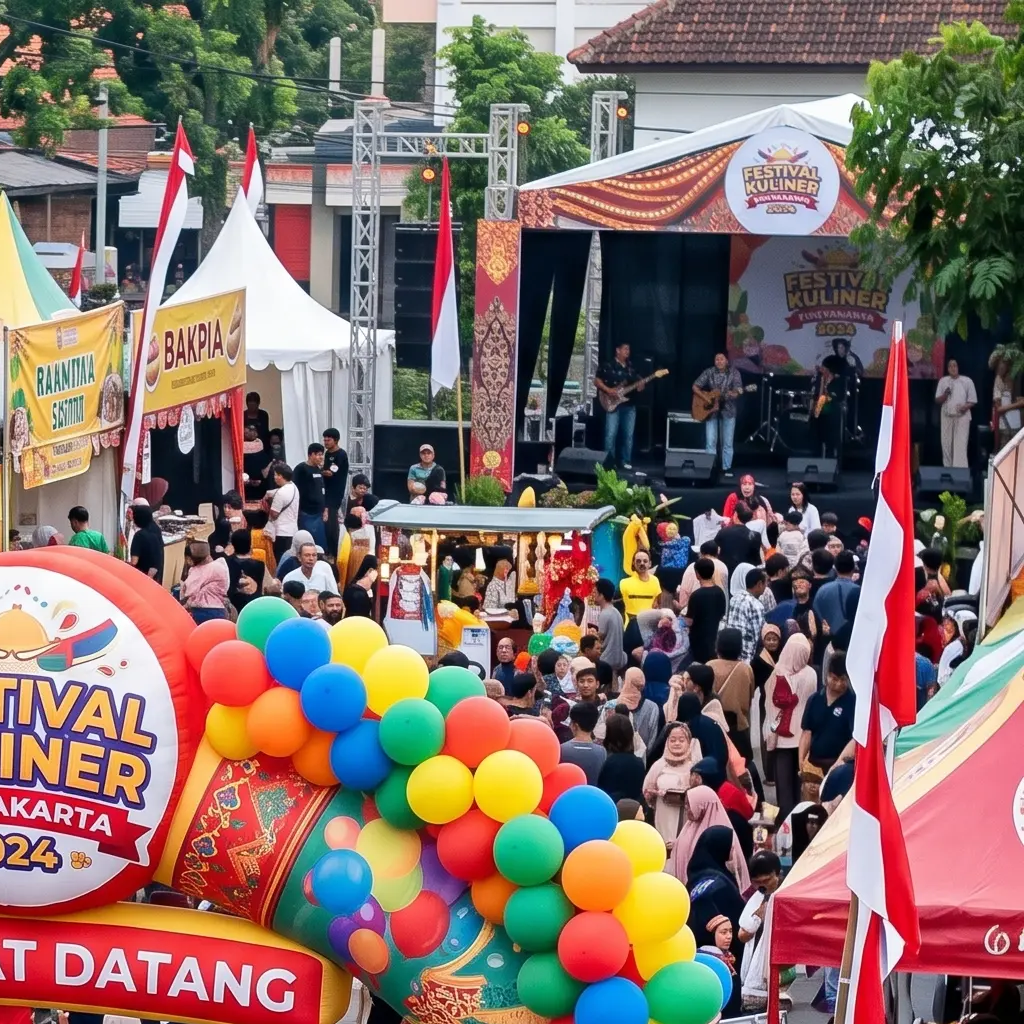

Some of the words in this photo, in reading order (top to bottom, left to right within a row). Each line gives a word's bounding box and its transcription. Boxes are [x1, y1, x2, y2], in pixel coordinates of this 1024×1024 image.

[743, 165, 820, 181] FESTIVAL
[745, 178, 820, 196] KULINER
[787, 288, 888, 311] KULINER
[164, 319, 224, 371] BAKPIA
[54, 942, 298, 1013] DATANG
